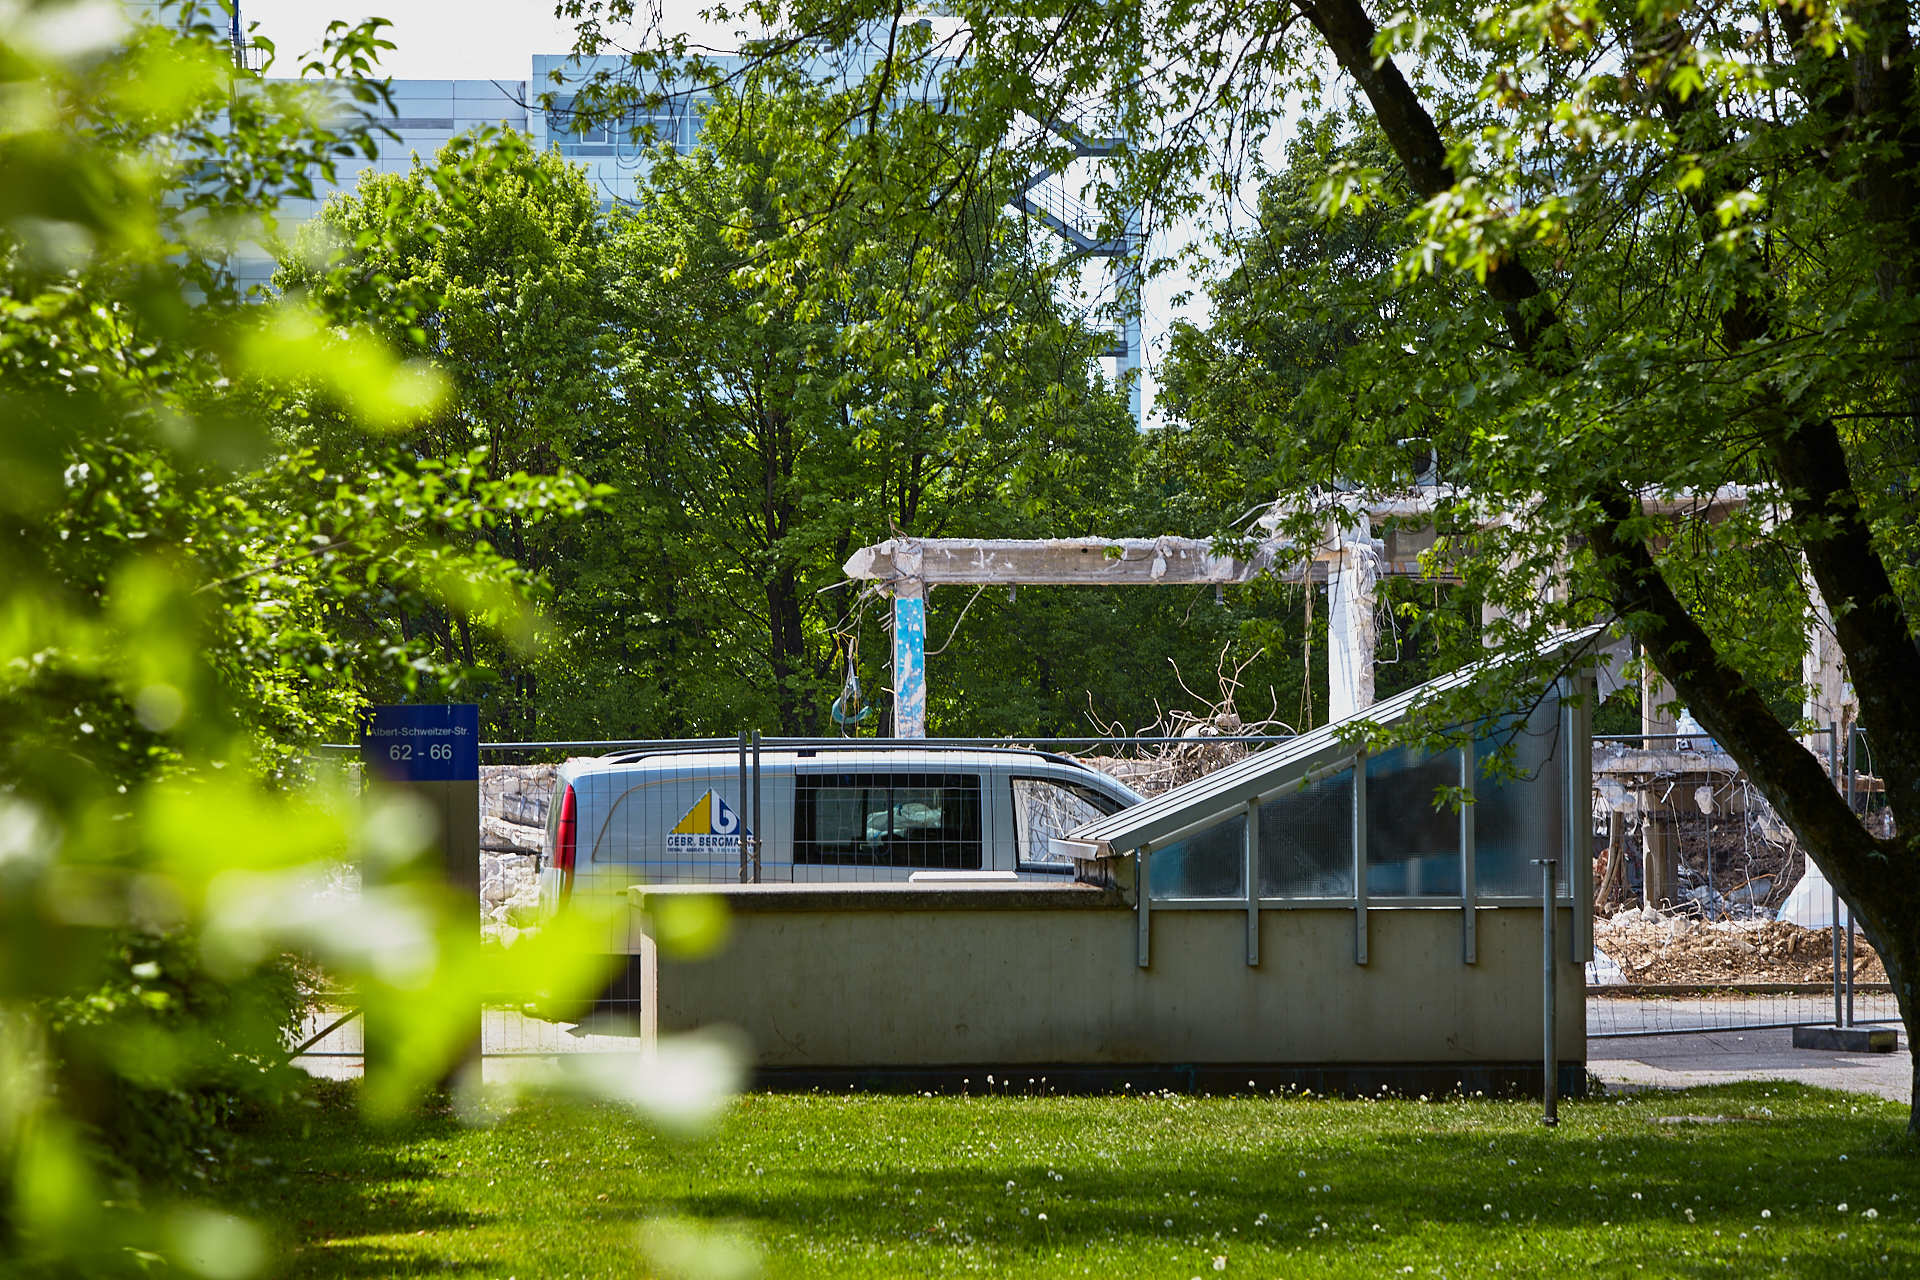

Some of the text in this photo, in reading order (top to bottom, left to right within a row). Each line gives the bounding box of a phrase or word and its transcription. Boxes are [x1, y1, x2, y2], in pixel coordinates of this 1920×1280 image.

[371, 726, 469, 736] Albert-Schweitzer-Str.
[389, 744, 412, 760] 62
[430, 744, 452, 760] 66
[667, 836, 696, 846] GEBR.
